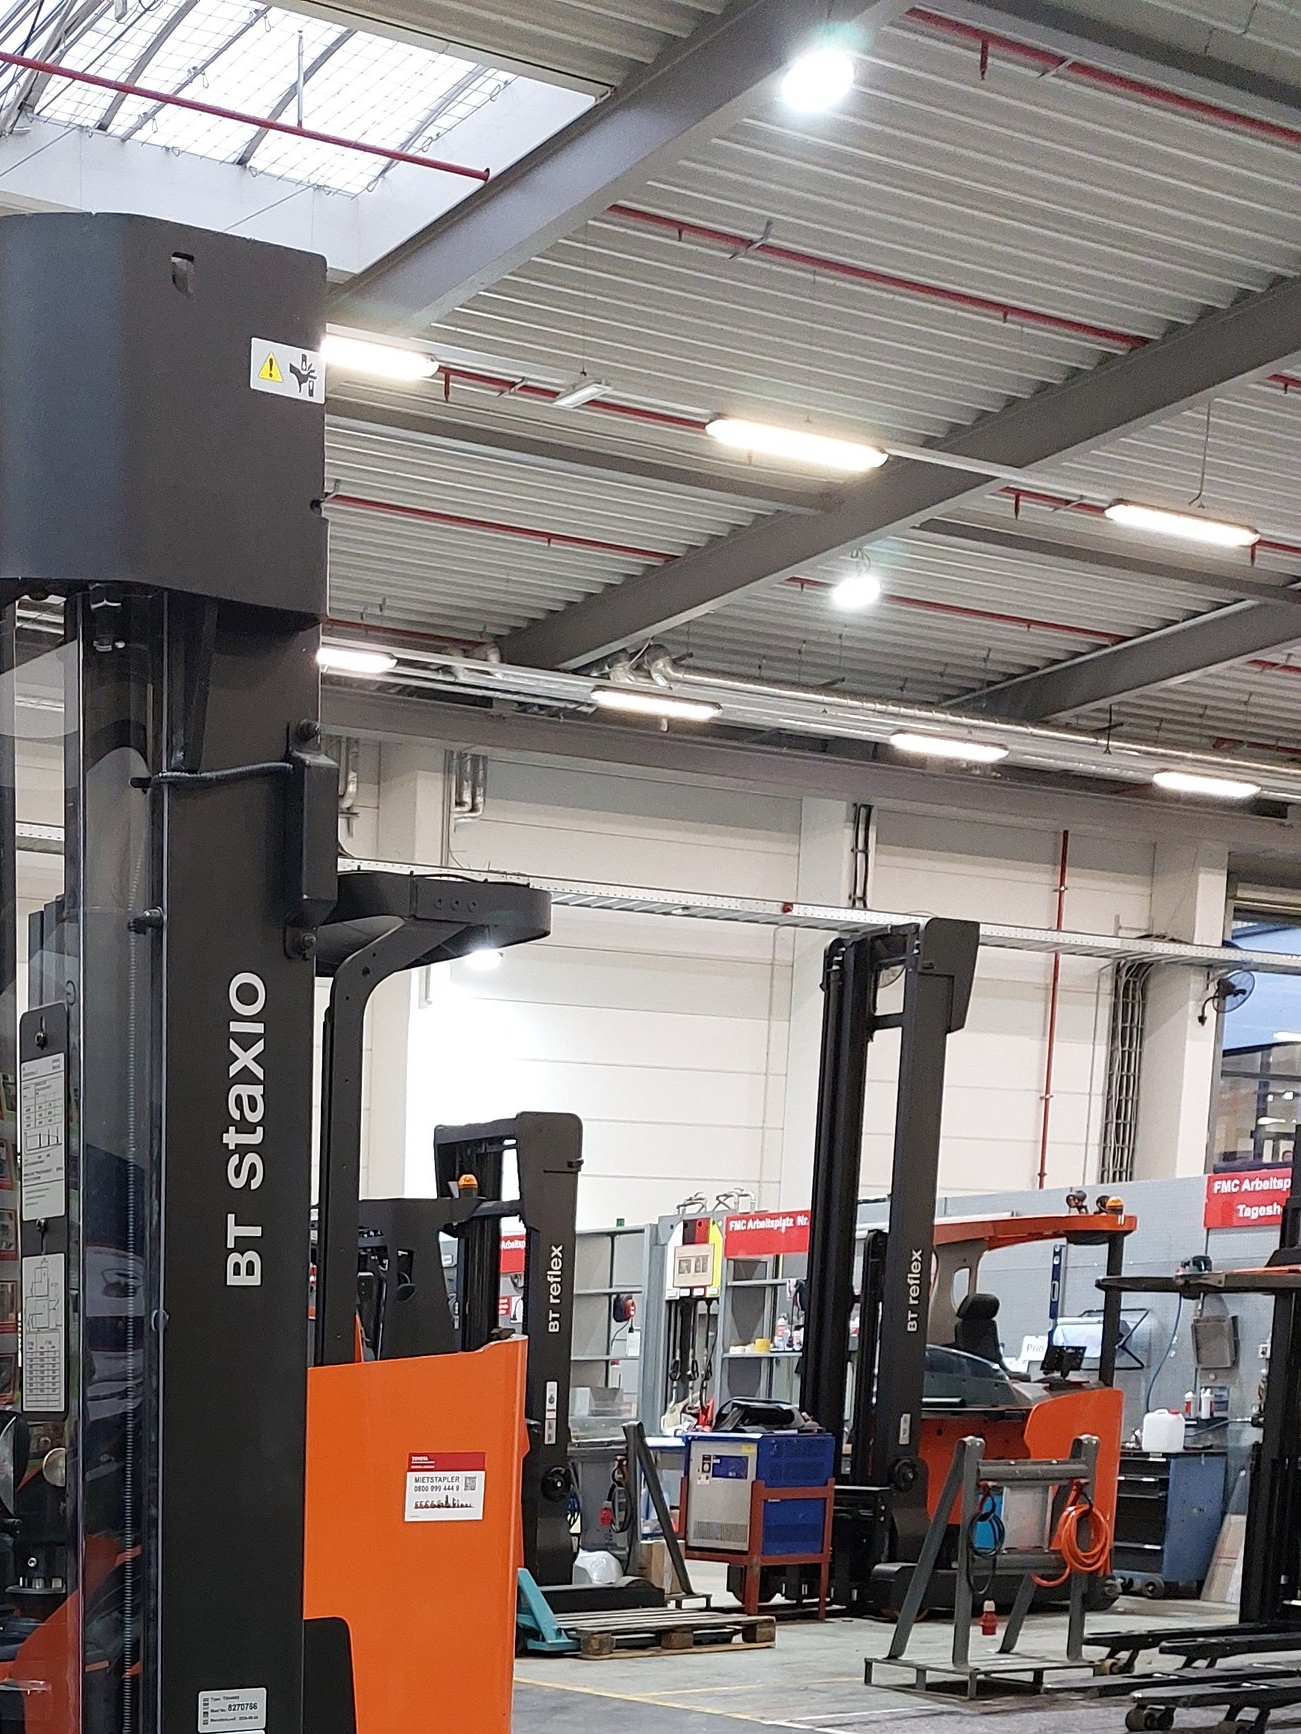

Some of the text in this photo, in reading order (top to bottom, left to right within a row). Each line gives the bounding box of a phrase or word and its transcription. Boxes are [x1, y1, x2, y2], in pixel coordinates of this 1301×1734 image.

[222, 971, 266, 1286] BT staxio
[1213, 1179, 1240, 1194] FMC
[1237, 1202, 1282, 1220] Tagesh
[729, 1220, 747, 1232] FMC
[547, 1244, 564, 1333] BT reflex
[907, 1249, 923, 1332] BT reflex
[414, 1476, 460, 1484] MIETSTAPLER
